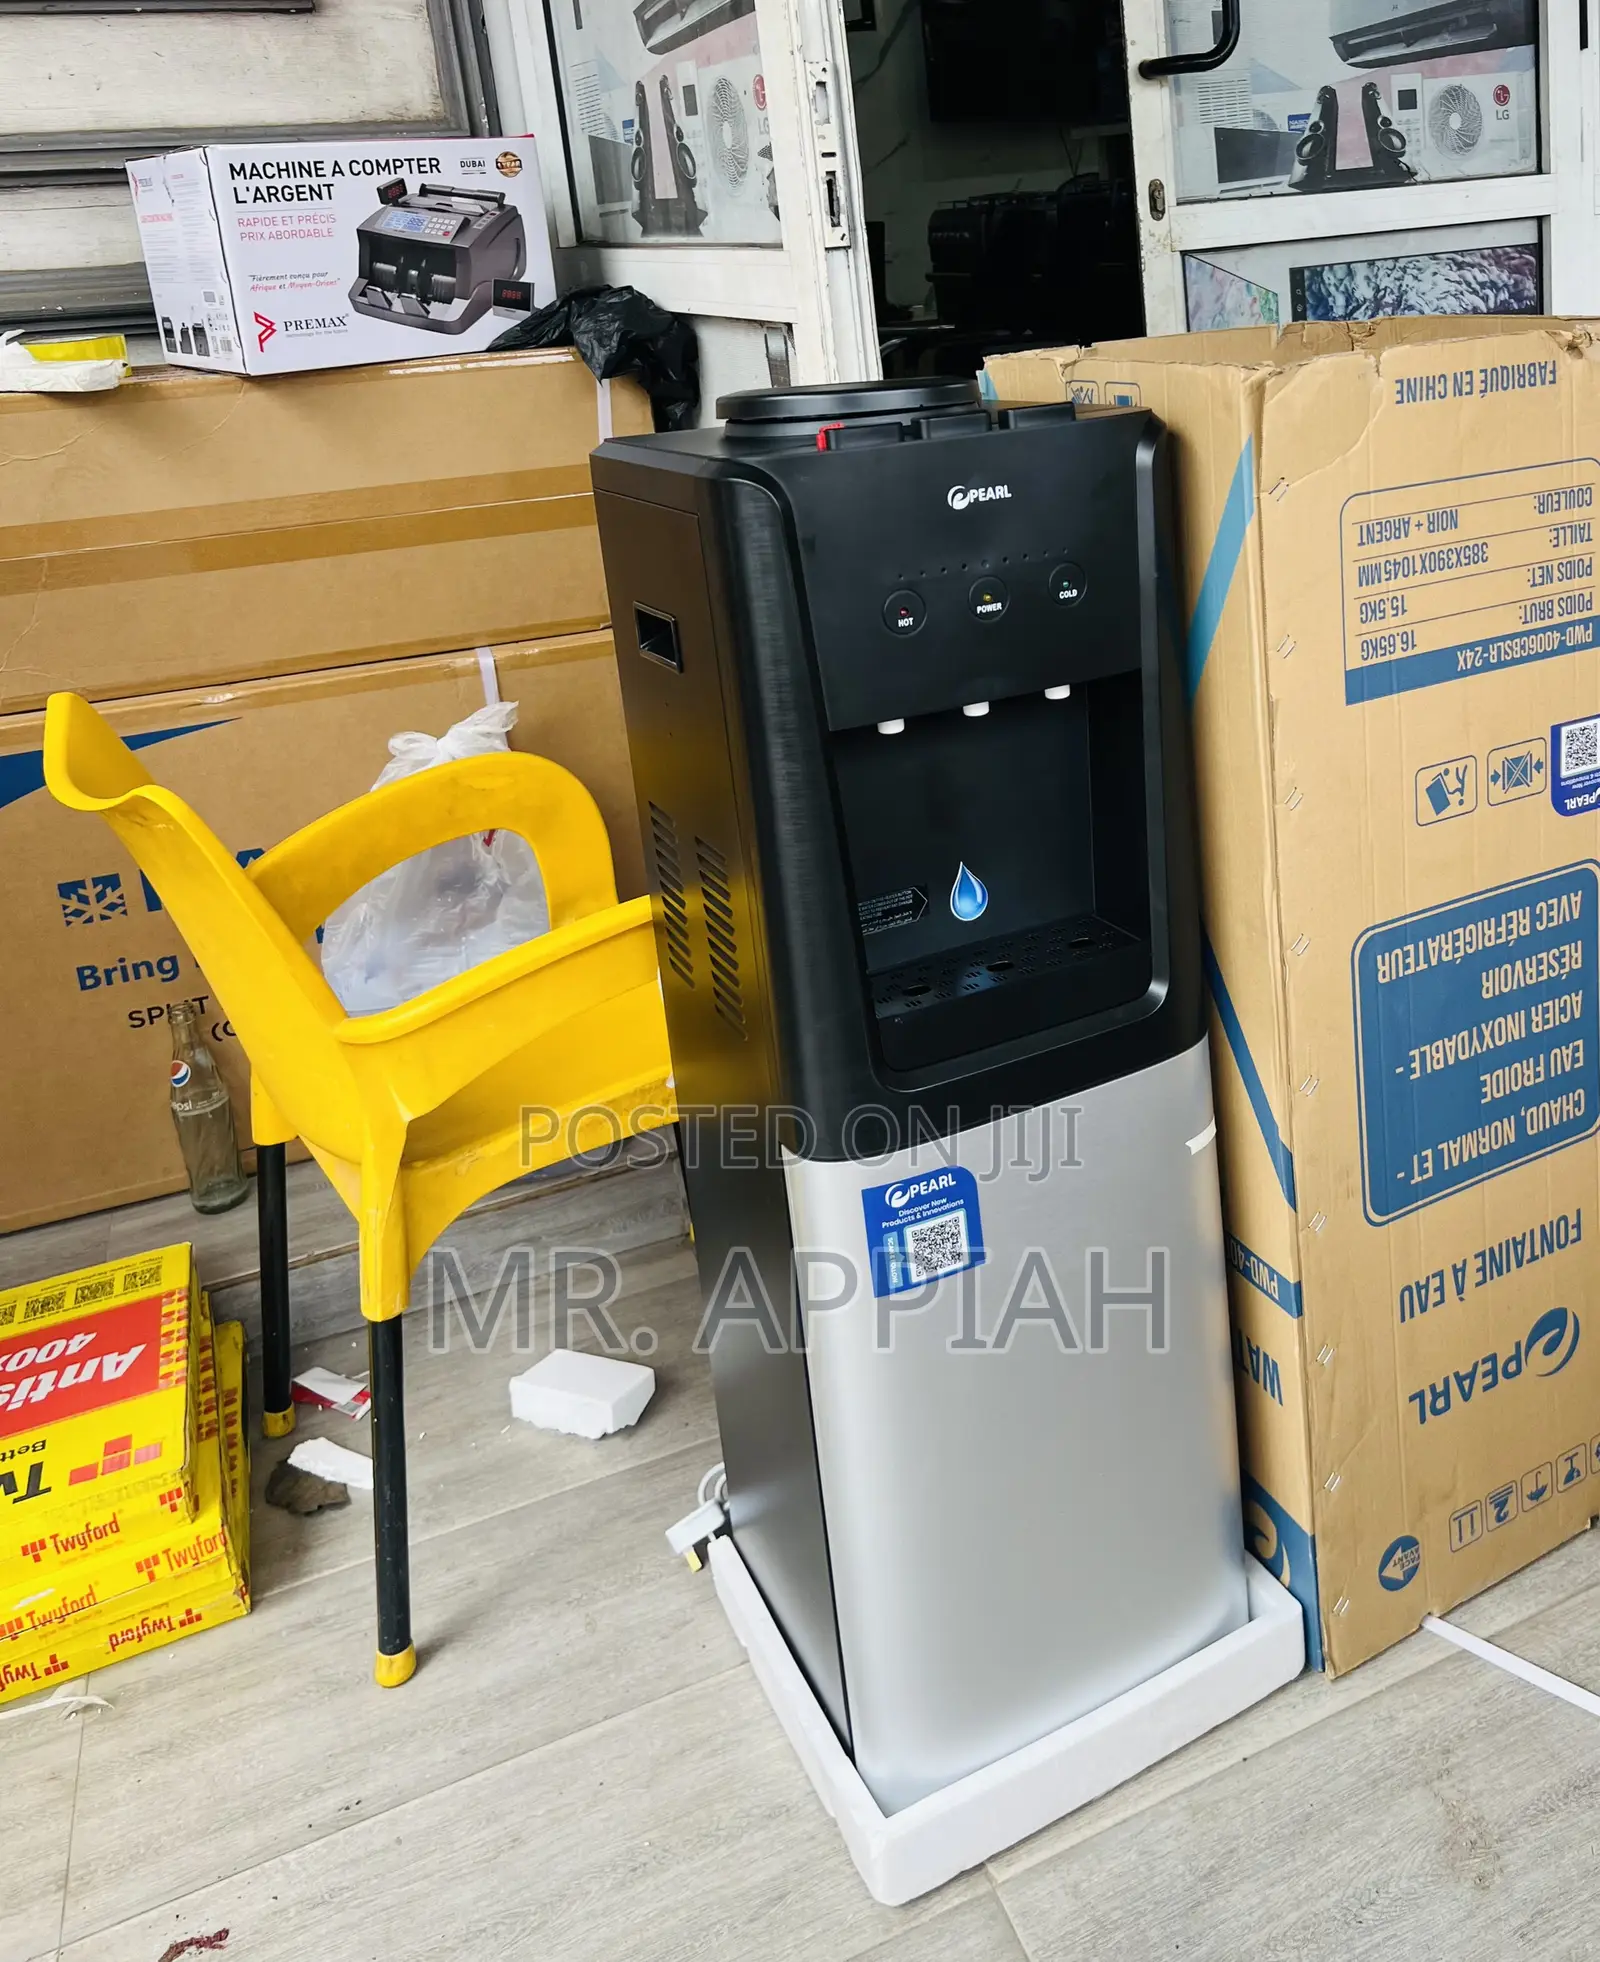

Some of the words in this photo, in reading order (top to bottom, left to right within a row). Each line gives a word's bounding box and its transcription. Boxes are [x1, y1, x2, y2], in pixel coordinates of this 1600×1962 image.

[758, 117, 770, 135] LG
[1495, 109, 1510, 120] LG
[229, 160, 326, 180] MACHINE
[332, 160, 345, 176] A
[349, 157, 442, 176] COMPTER
[460, 160, 486, 168] DUBAI
[233, 184, 334, 204] L'ARGENT
[238, 216, 278, 228] RAPIDE
[282, 215, 294, 226] ET
[298, 212, 336, 224] PRÉCIS
[240, 230, 266, 242] PRIX
[268, 228, 334, 240] ABORDABLE
[250, 284, 276, 292] Afrique
[1395, 374, 1447, 404] CHINE
[1453, 370, 1473, 397] EN
[1479, 360, 1556, 398] FABRIQUÉ
[969, 484, 1012, 503] PEARL
[1533, 486, 1592, 514] COULEUR:
[1357, 517, 1411, 547] ARGENT
[1415, 519, 1423, 530] +
[1427, 509, 1458, 533] NOIR
[1549, 522, 1592, 548] TAILLE:
[1527, 564, 1554, 588] NET:
[1557, 557, 1592, 582] POIDS
[976, 603, 1002, 614] POWER
[1059, 589, 1077, 599] COLD
[1359, 594, 1408, 624] 15.5KG
[1557, 592, 1592, 616] POIDS
[898, 618, 913, 628] HOT
[1519, 599, 1554, 624] BRUT:
[1361, 630, 1417, 661] 16.65KG
[1456, 622, 1593, 671] PWD-4006CBSLR-24X
[1564, 792, 1596, 810] PEARL
[1536, 890, 1582, 931] AVEC
[1377, 906, 1530, 983] RÉFRIGÉRATEUR
[76, 955, 180, 991] Bring
[1481, 940, 1582, 999] RÉSERVOIR
[128, 995, 209, 1028] SPT
[1531, 990, 1583, 1033] ACIER
[1409, 1010, 1526, 1080] INOXYDABLE
[1550, 1039, 1584, 1077] EAU
[1480, 1053, 1545, 1104] FROIDE
[1521, 1088, 1585, 1135] CHAUD,
[1437, 1115, 1515, 1170] NORMAL
[1410, 1148, 1433, 1184] ET
[910, 1173, 956, 1198] PEARL
[882, 1215, 915, 1228] Products
[923, 1199, 964, 1216] Innovations
[899, 1201, 930, 1217] Discover
[931, 1198, 947, 1207] Now
[1474, 1208, 1582, 1288] FONTAINE
[1226, 1237, 1279, 1301] PWD-40
[1451, 1258, 1467, 1302] À
[1399, 1269, 1445, 1323] EAU
[1408, 1340, 1523, 1425] PEARL
[50, 1512, 120, 1555] Twyford
[26, 1583, 98, 1631] Twyford
[109, 1616, 176, 1652] Twyford
